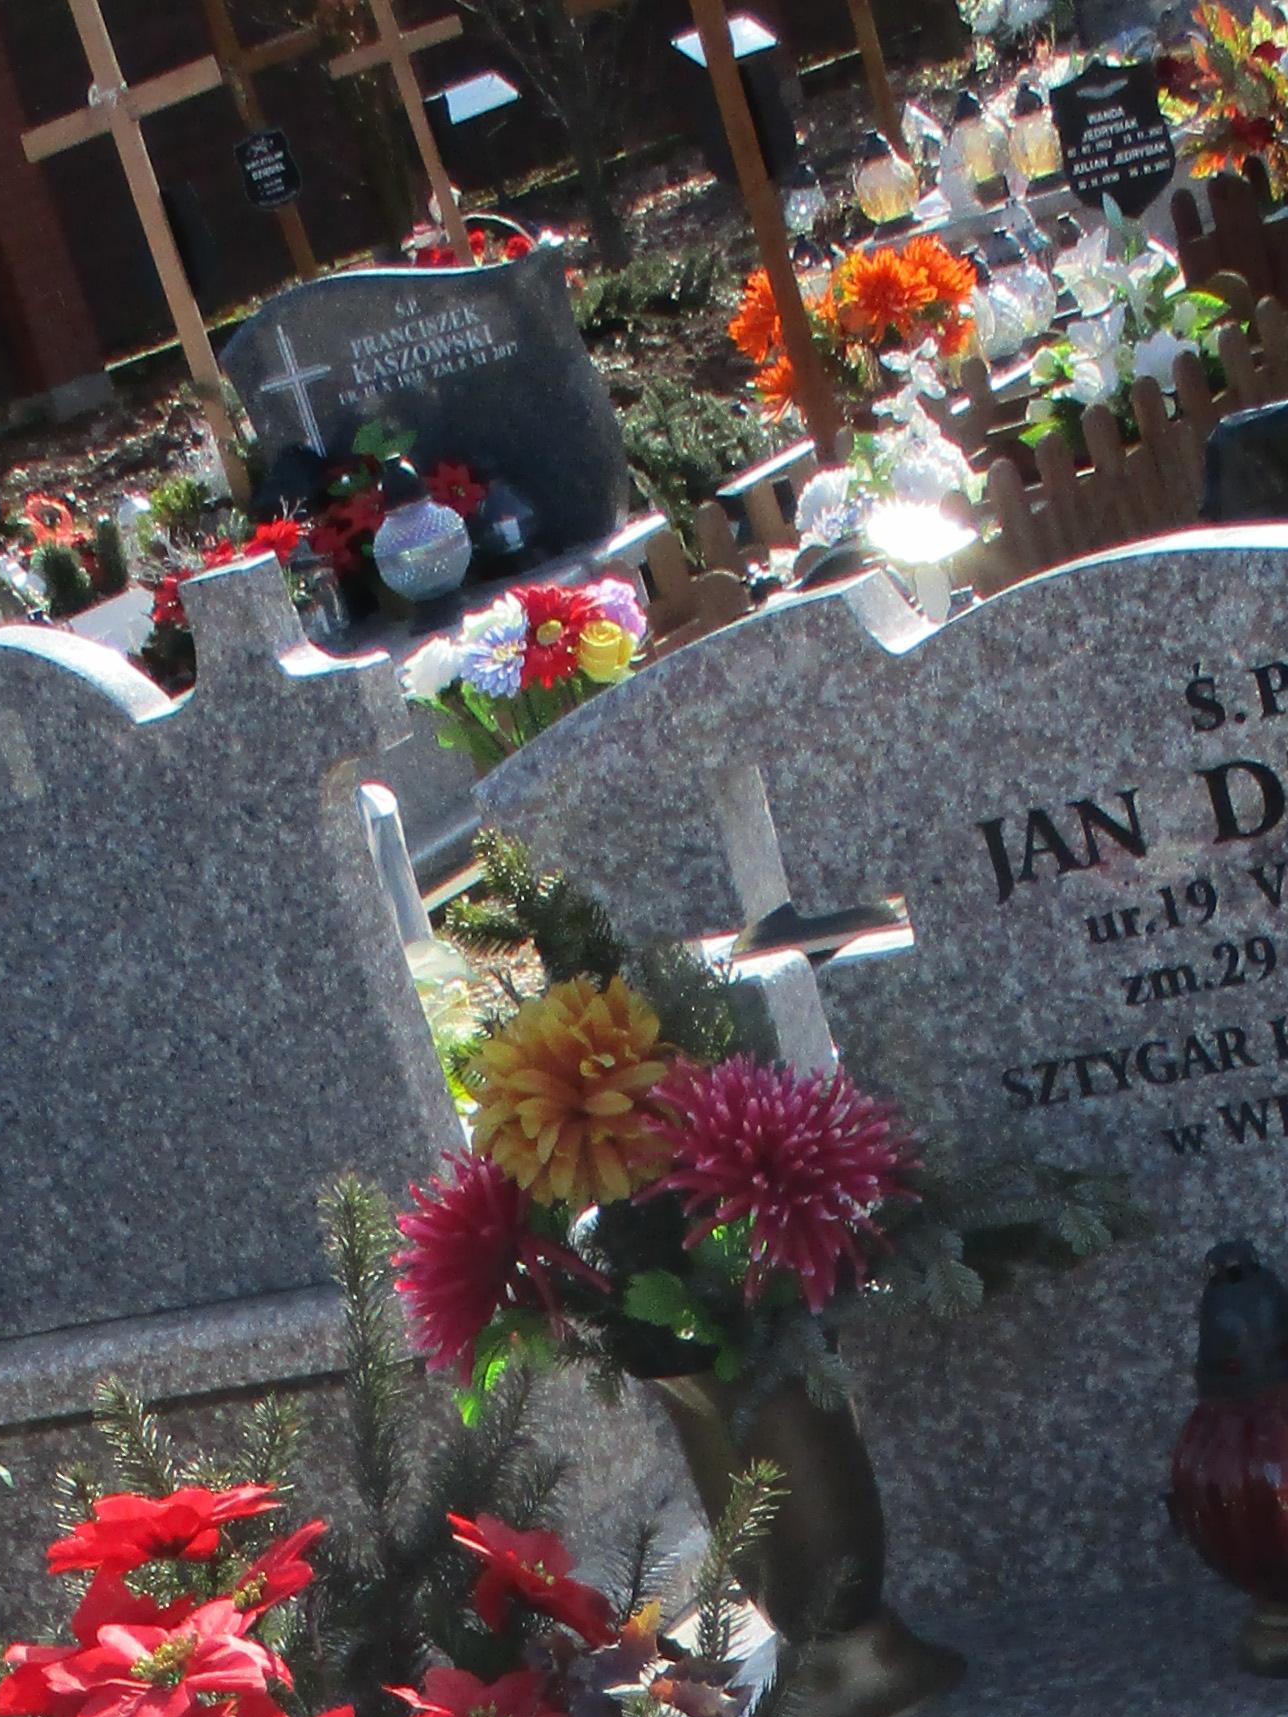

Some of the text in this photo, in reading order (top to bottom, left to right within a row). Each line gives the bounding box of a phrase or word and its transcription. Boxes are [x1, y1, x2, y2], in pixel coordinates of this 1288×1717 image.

[350, 303, 480, 359] FRANCISZEK
[352, 324, 493, 384] KASZOWSKI
[975, 788, 1149, 904] JAN
[1002, 1030, 1260, 1113] SZTYGAR
[1161, 1122, 1210, 1158] w
